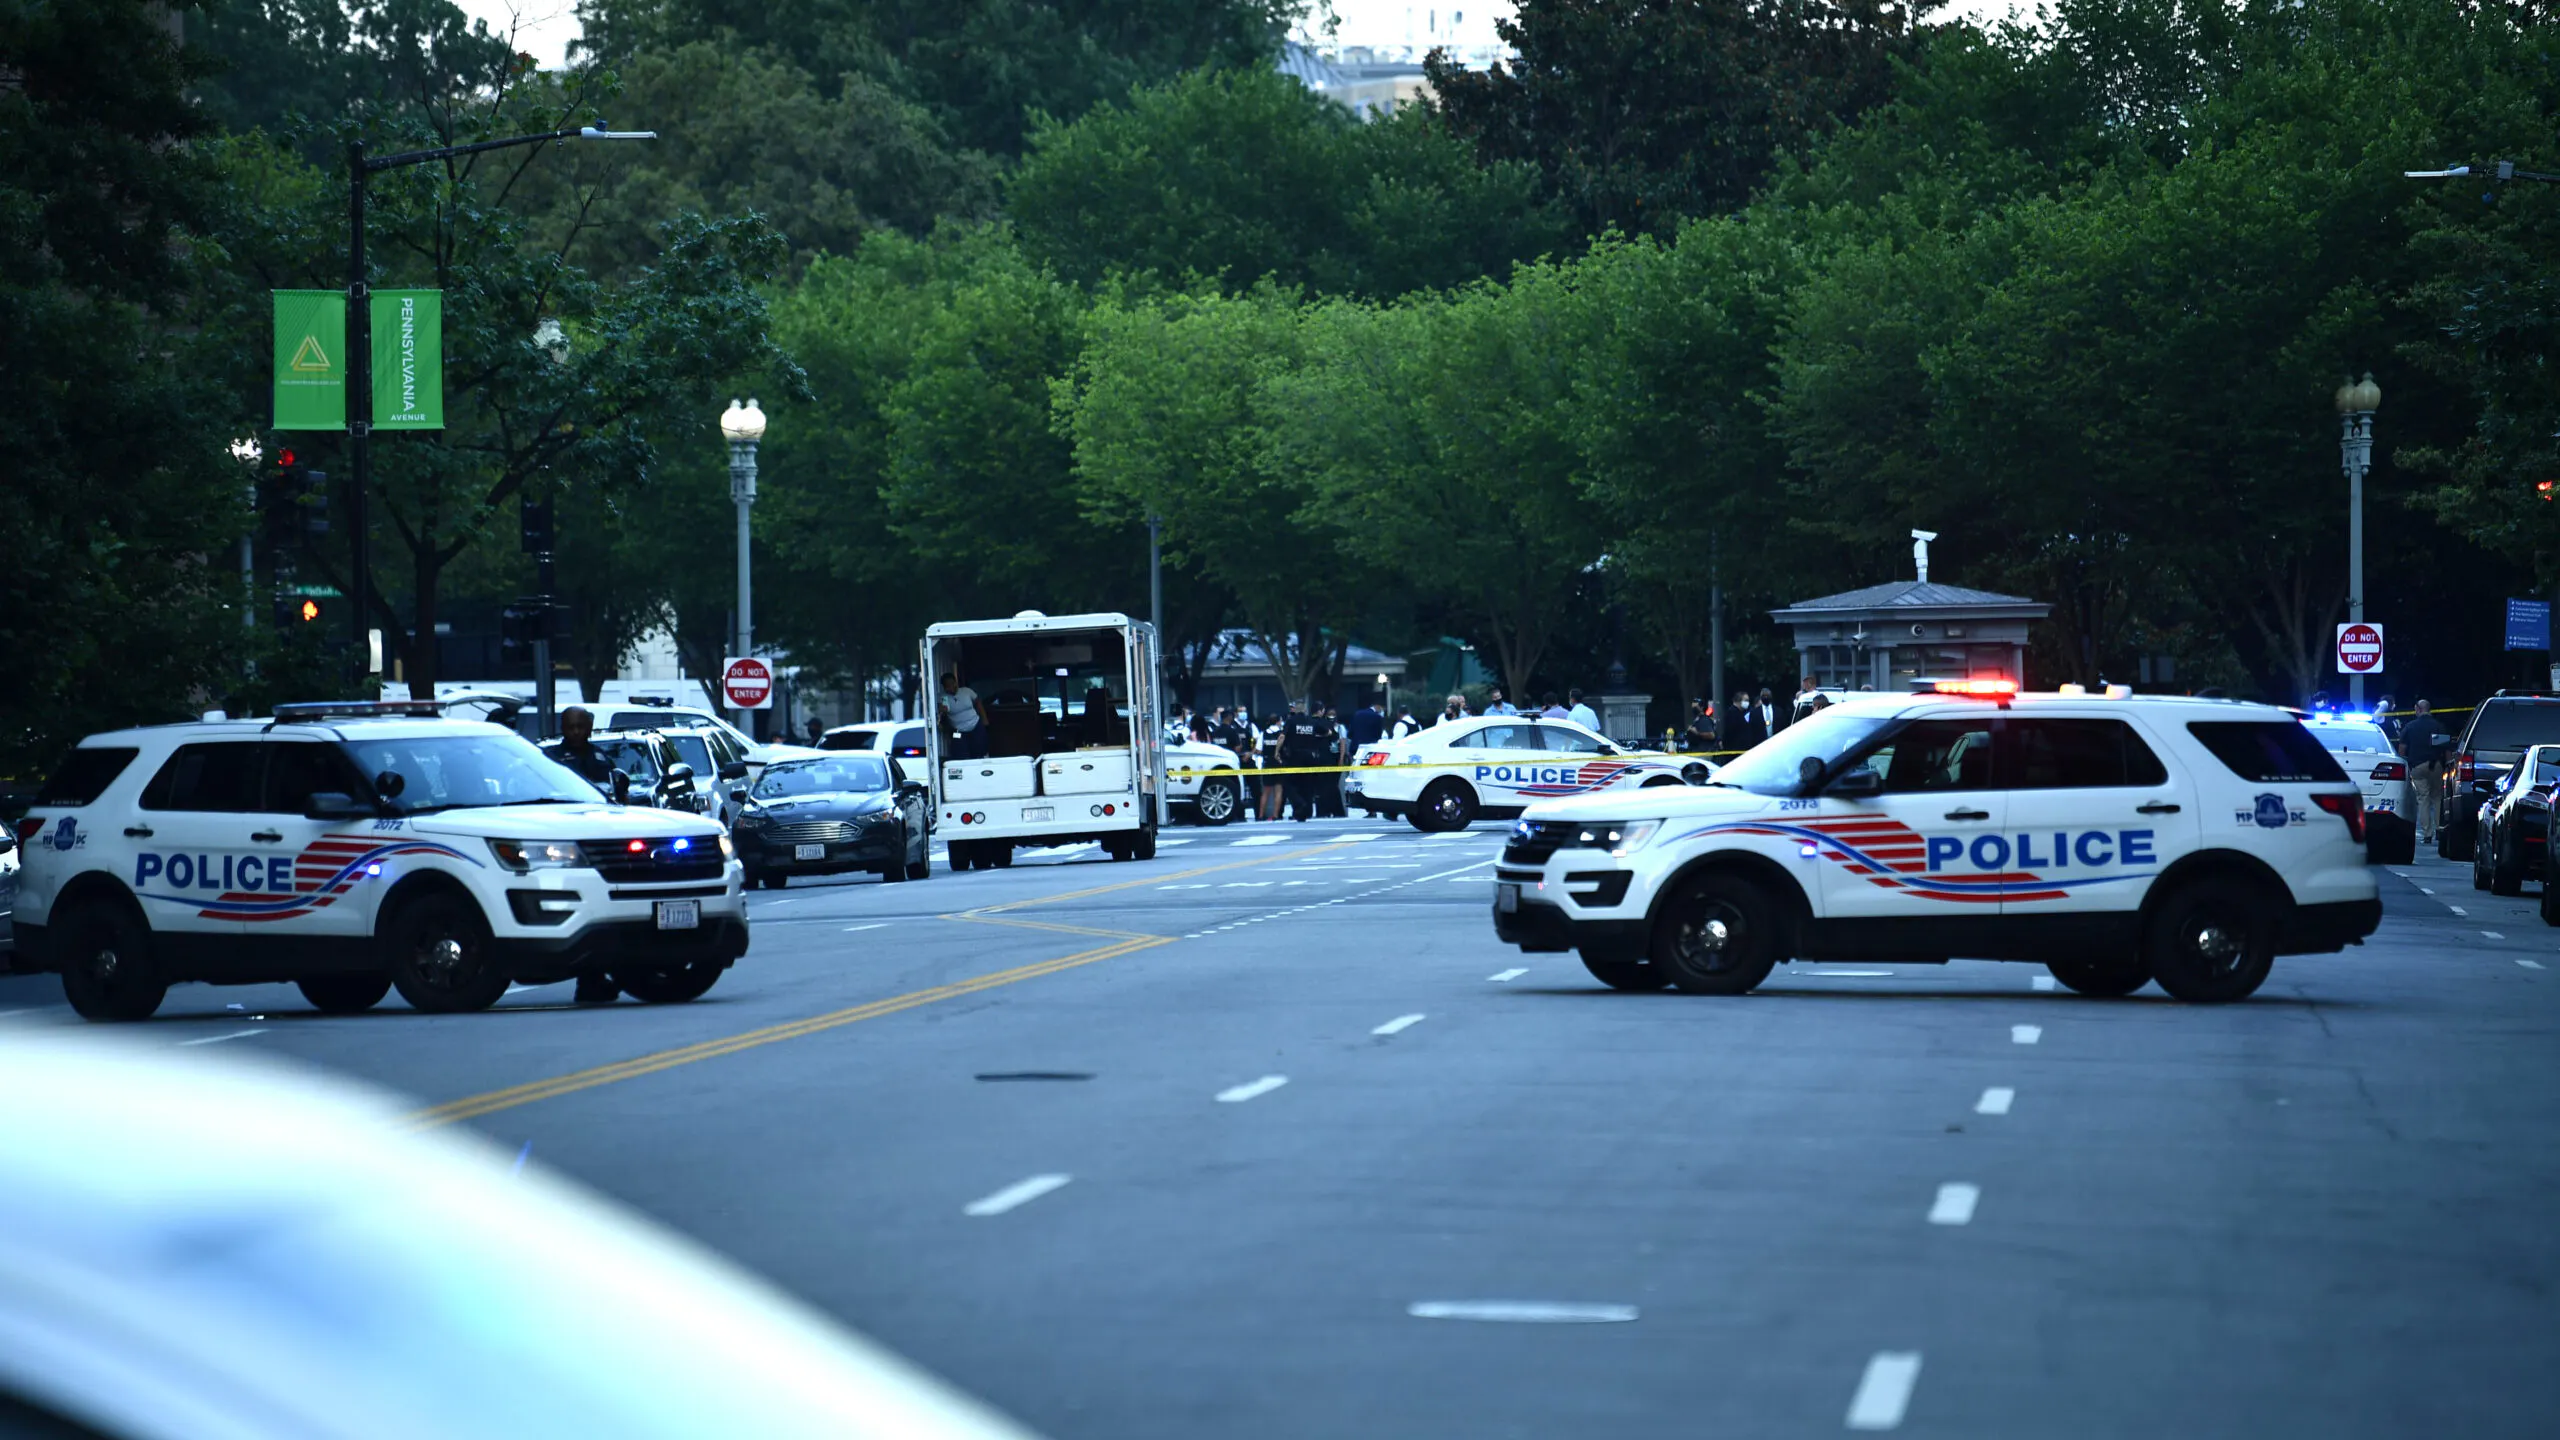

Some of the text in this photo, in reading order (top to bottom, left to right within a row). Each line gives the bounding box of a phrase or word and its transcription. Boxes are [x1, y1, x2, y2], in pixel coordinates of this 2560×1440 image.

[401, 298, 415, 412] PENNSYLVANIA
[2345, 634, 2375, 642] DO NOT
[2347, 654, 2373, 663] ENTER
[731, 668, 764, 676] DO NOT
[734, 689, 761, 698] ENTER
[1476, 766, 1577, 785] POLICE
[1779, 800, 1819, 810] 2073
[2236, 812, 2306, 822] MP DC
[373, 819, 403, 830] 2072
[1928, 830, 2157, 871] POLICE
[135, 853, 292, 892] POLICE
